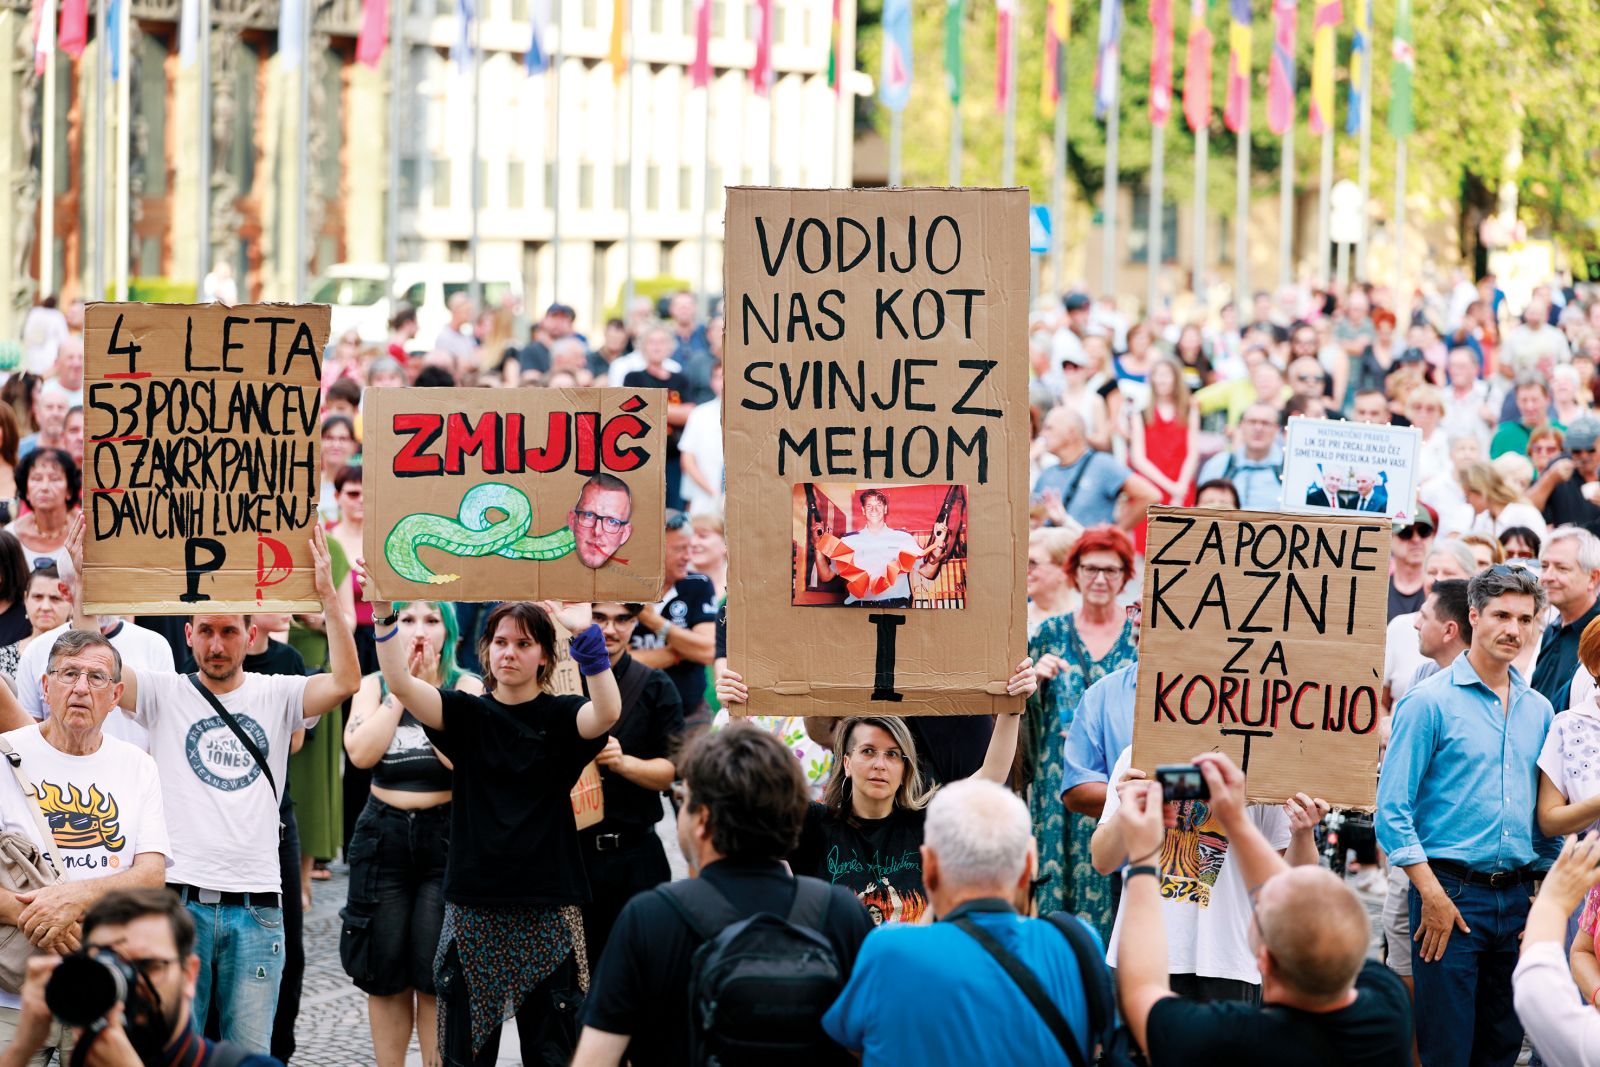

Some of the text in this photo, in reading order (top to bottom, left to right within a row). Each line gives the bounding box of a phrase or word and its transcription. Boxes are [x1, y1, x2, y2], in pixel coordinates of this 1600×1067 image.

[755, 215, 961, 277] VODIJO
[742, 288, 985, 346] NAS KOT
[107, 313, 321, 381] 4 LETA
[88, 378, 321, 440] 53 POSLANCEV
[740, 359, 1004, 418] SVINJE Z
[392, 394, 653, 478] ZMIJIĆ
[777, 425, 989, 485] MEHOM
[213, 493, 312, 536] LUKENJ
[1150, 516, 1381, 571] ZAPORNE
[179, 537, 227, 603] P
[1151, 568, 1357, 635] KAZNI
[1222, 637, 1288, 676] ZA
[1154, 671, 1379, 735] KORUPCIJO
[206, 739, 240, 752] JACK
[206, 750, 251, 767] JONES
[193, 763, 260, 789] JEANSWEAR
